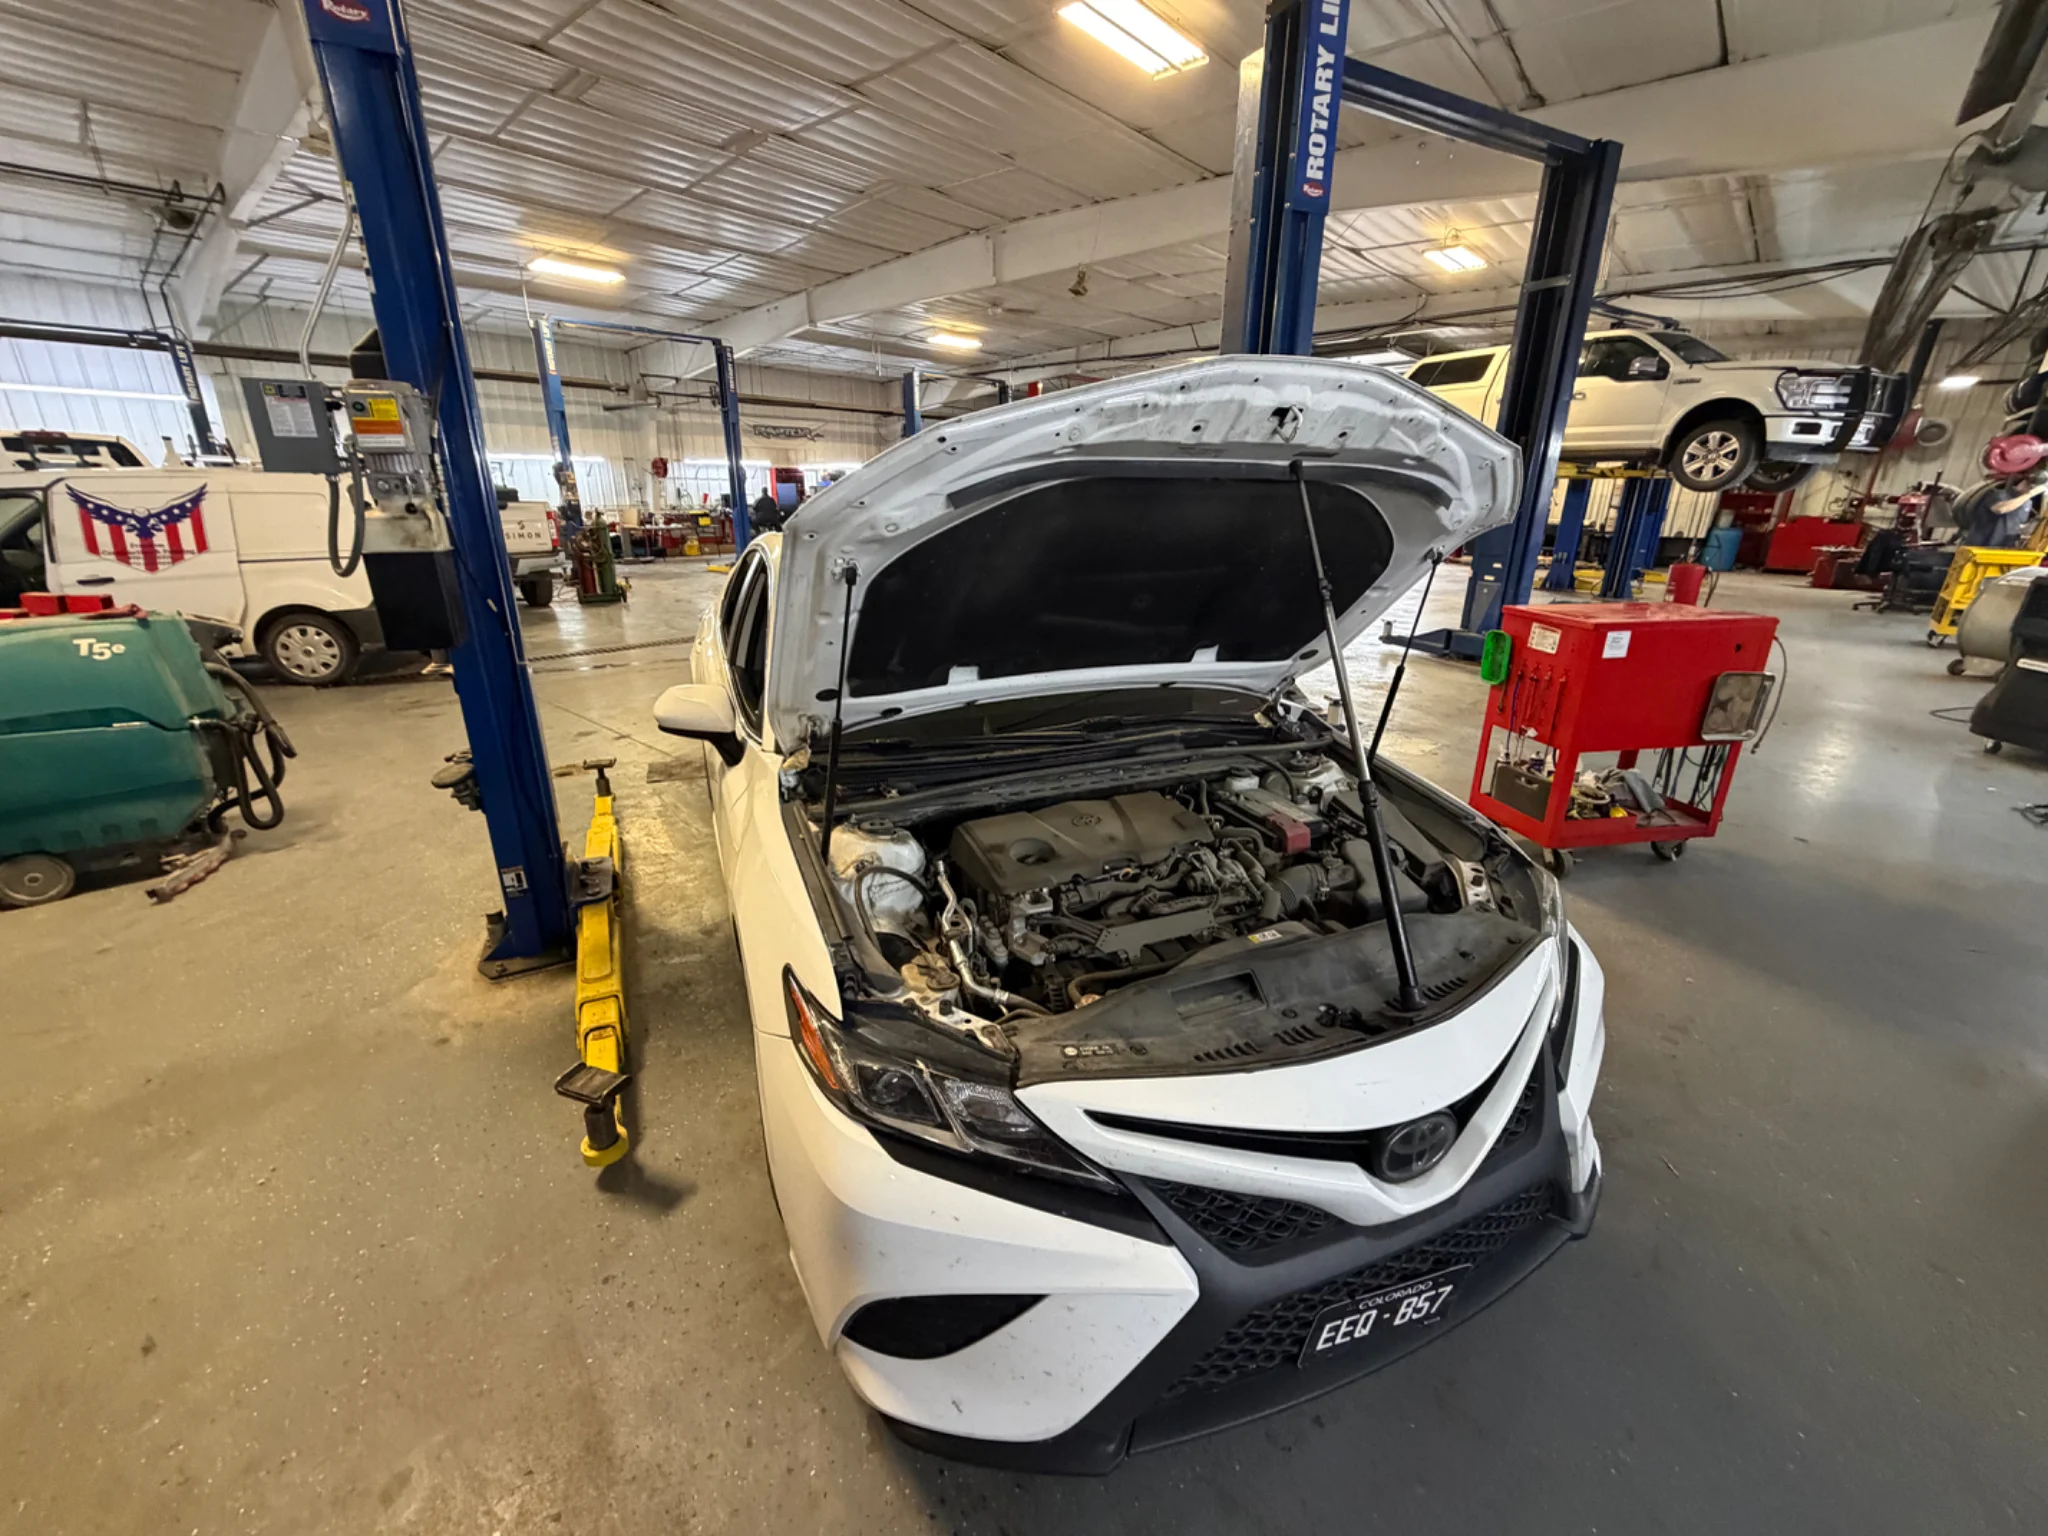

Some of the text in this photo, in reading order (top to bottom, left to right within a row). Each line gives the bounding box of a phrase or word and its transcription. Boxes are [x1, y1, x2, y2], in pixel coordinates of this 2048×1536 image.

[1306, 44, 1336, 180] ROTARY
[505, 532, 541, 540] SIMON
[72, 638, 126, 660] T5e
[1359, 1281, 1433, 1310] COLORADO
